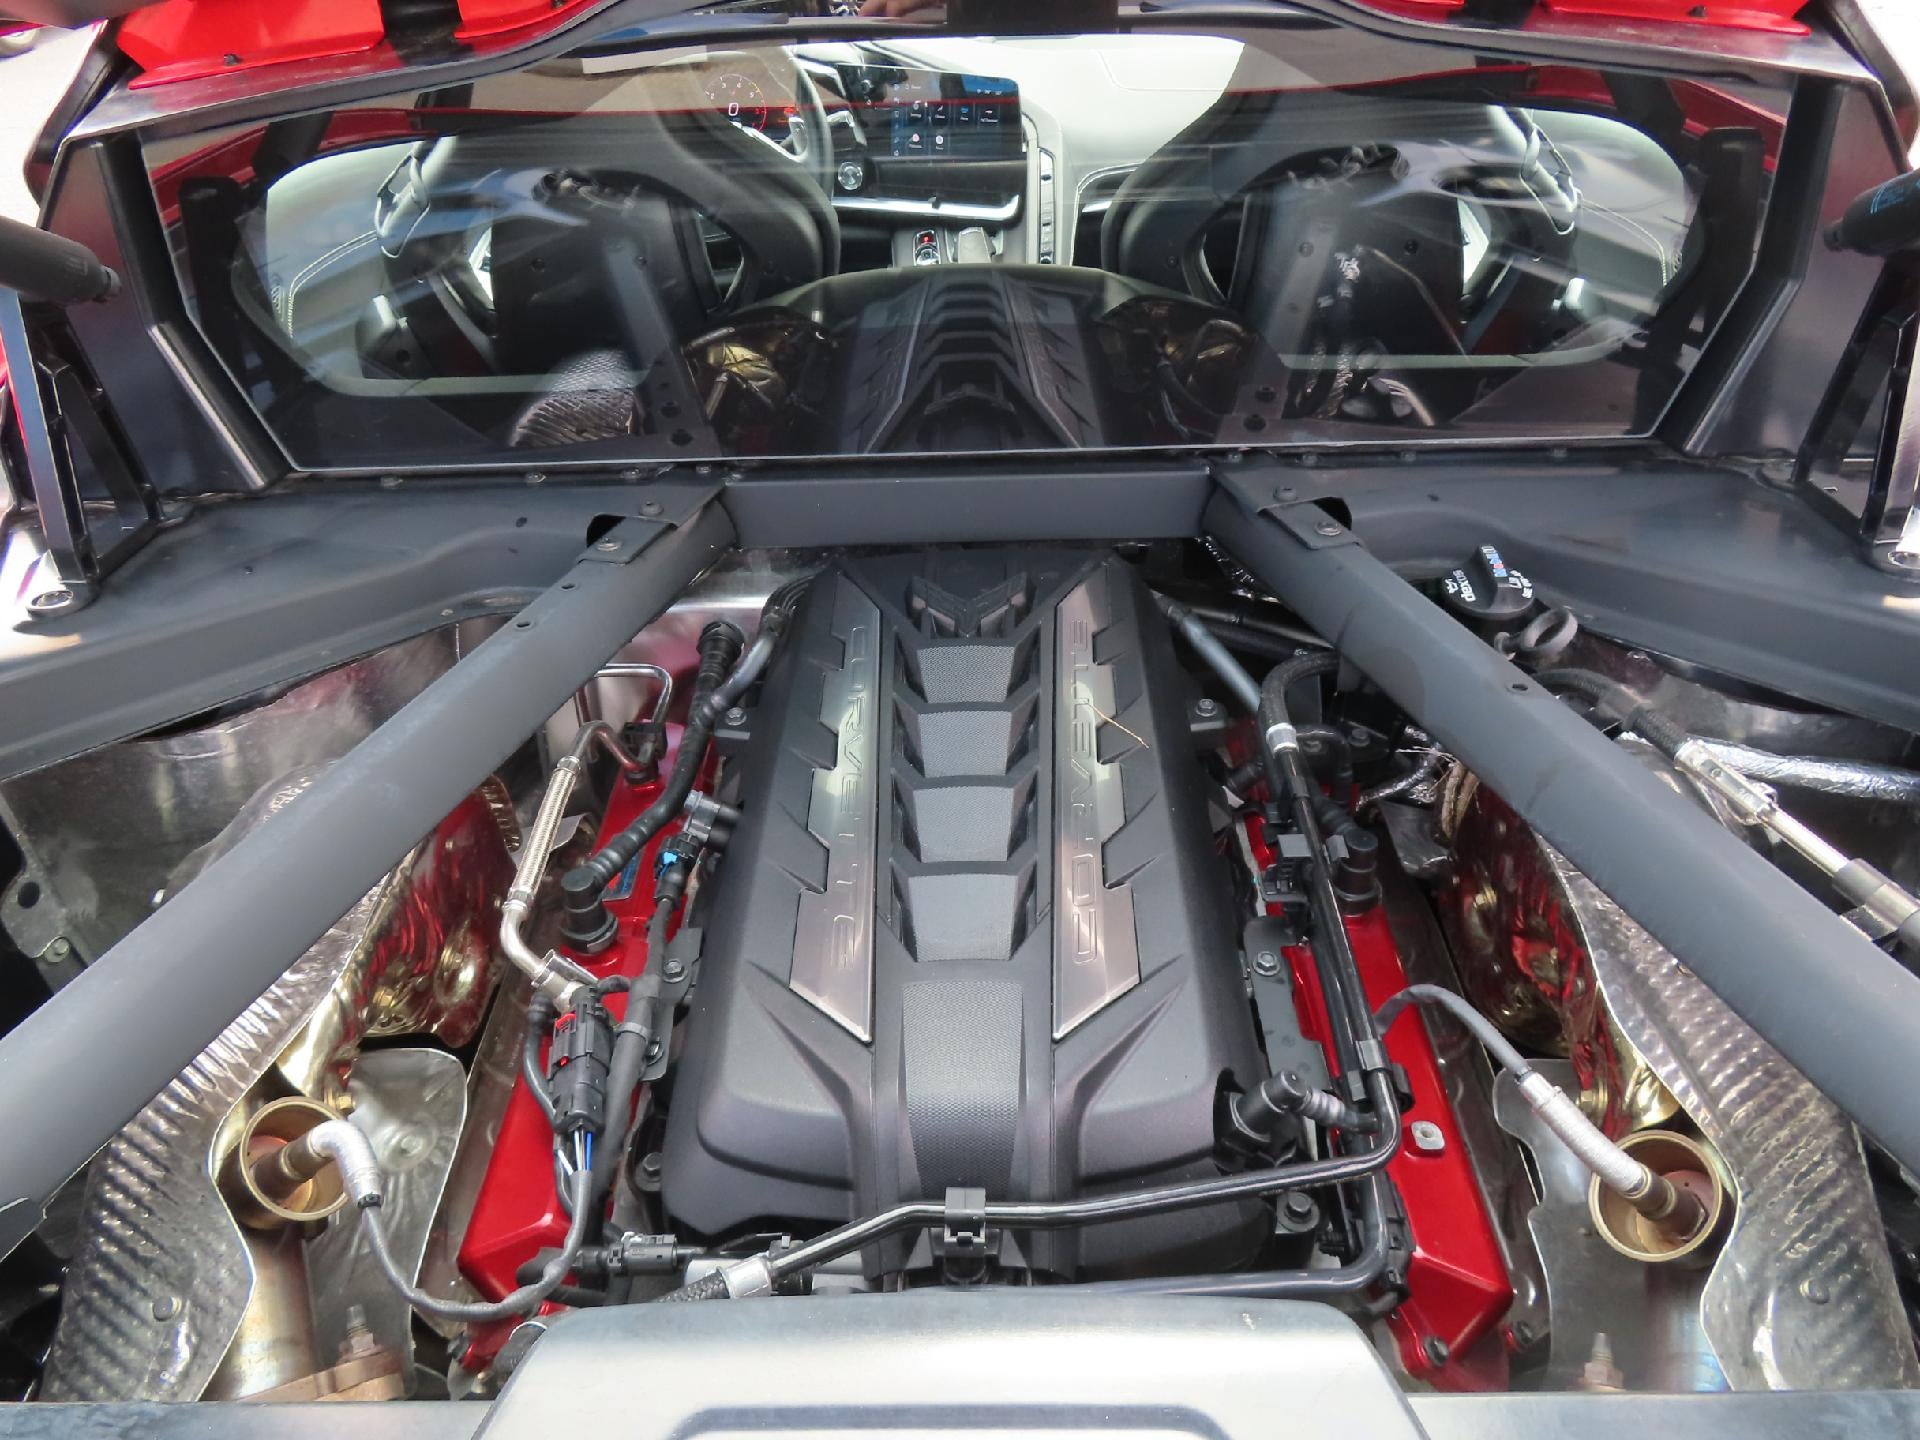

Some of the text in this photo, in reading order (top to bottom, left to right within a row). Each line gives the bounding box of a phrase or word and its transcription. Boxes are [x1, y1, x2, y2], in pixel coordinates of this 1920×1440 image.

[728, 102, 739, 116] 0
[1452, 569, 1477, 602] dexos
[832, 626, 864, 969] CORVETTE
[1069, 619, 1097, 965] CORVETTE
